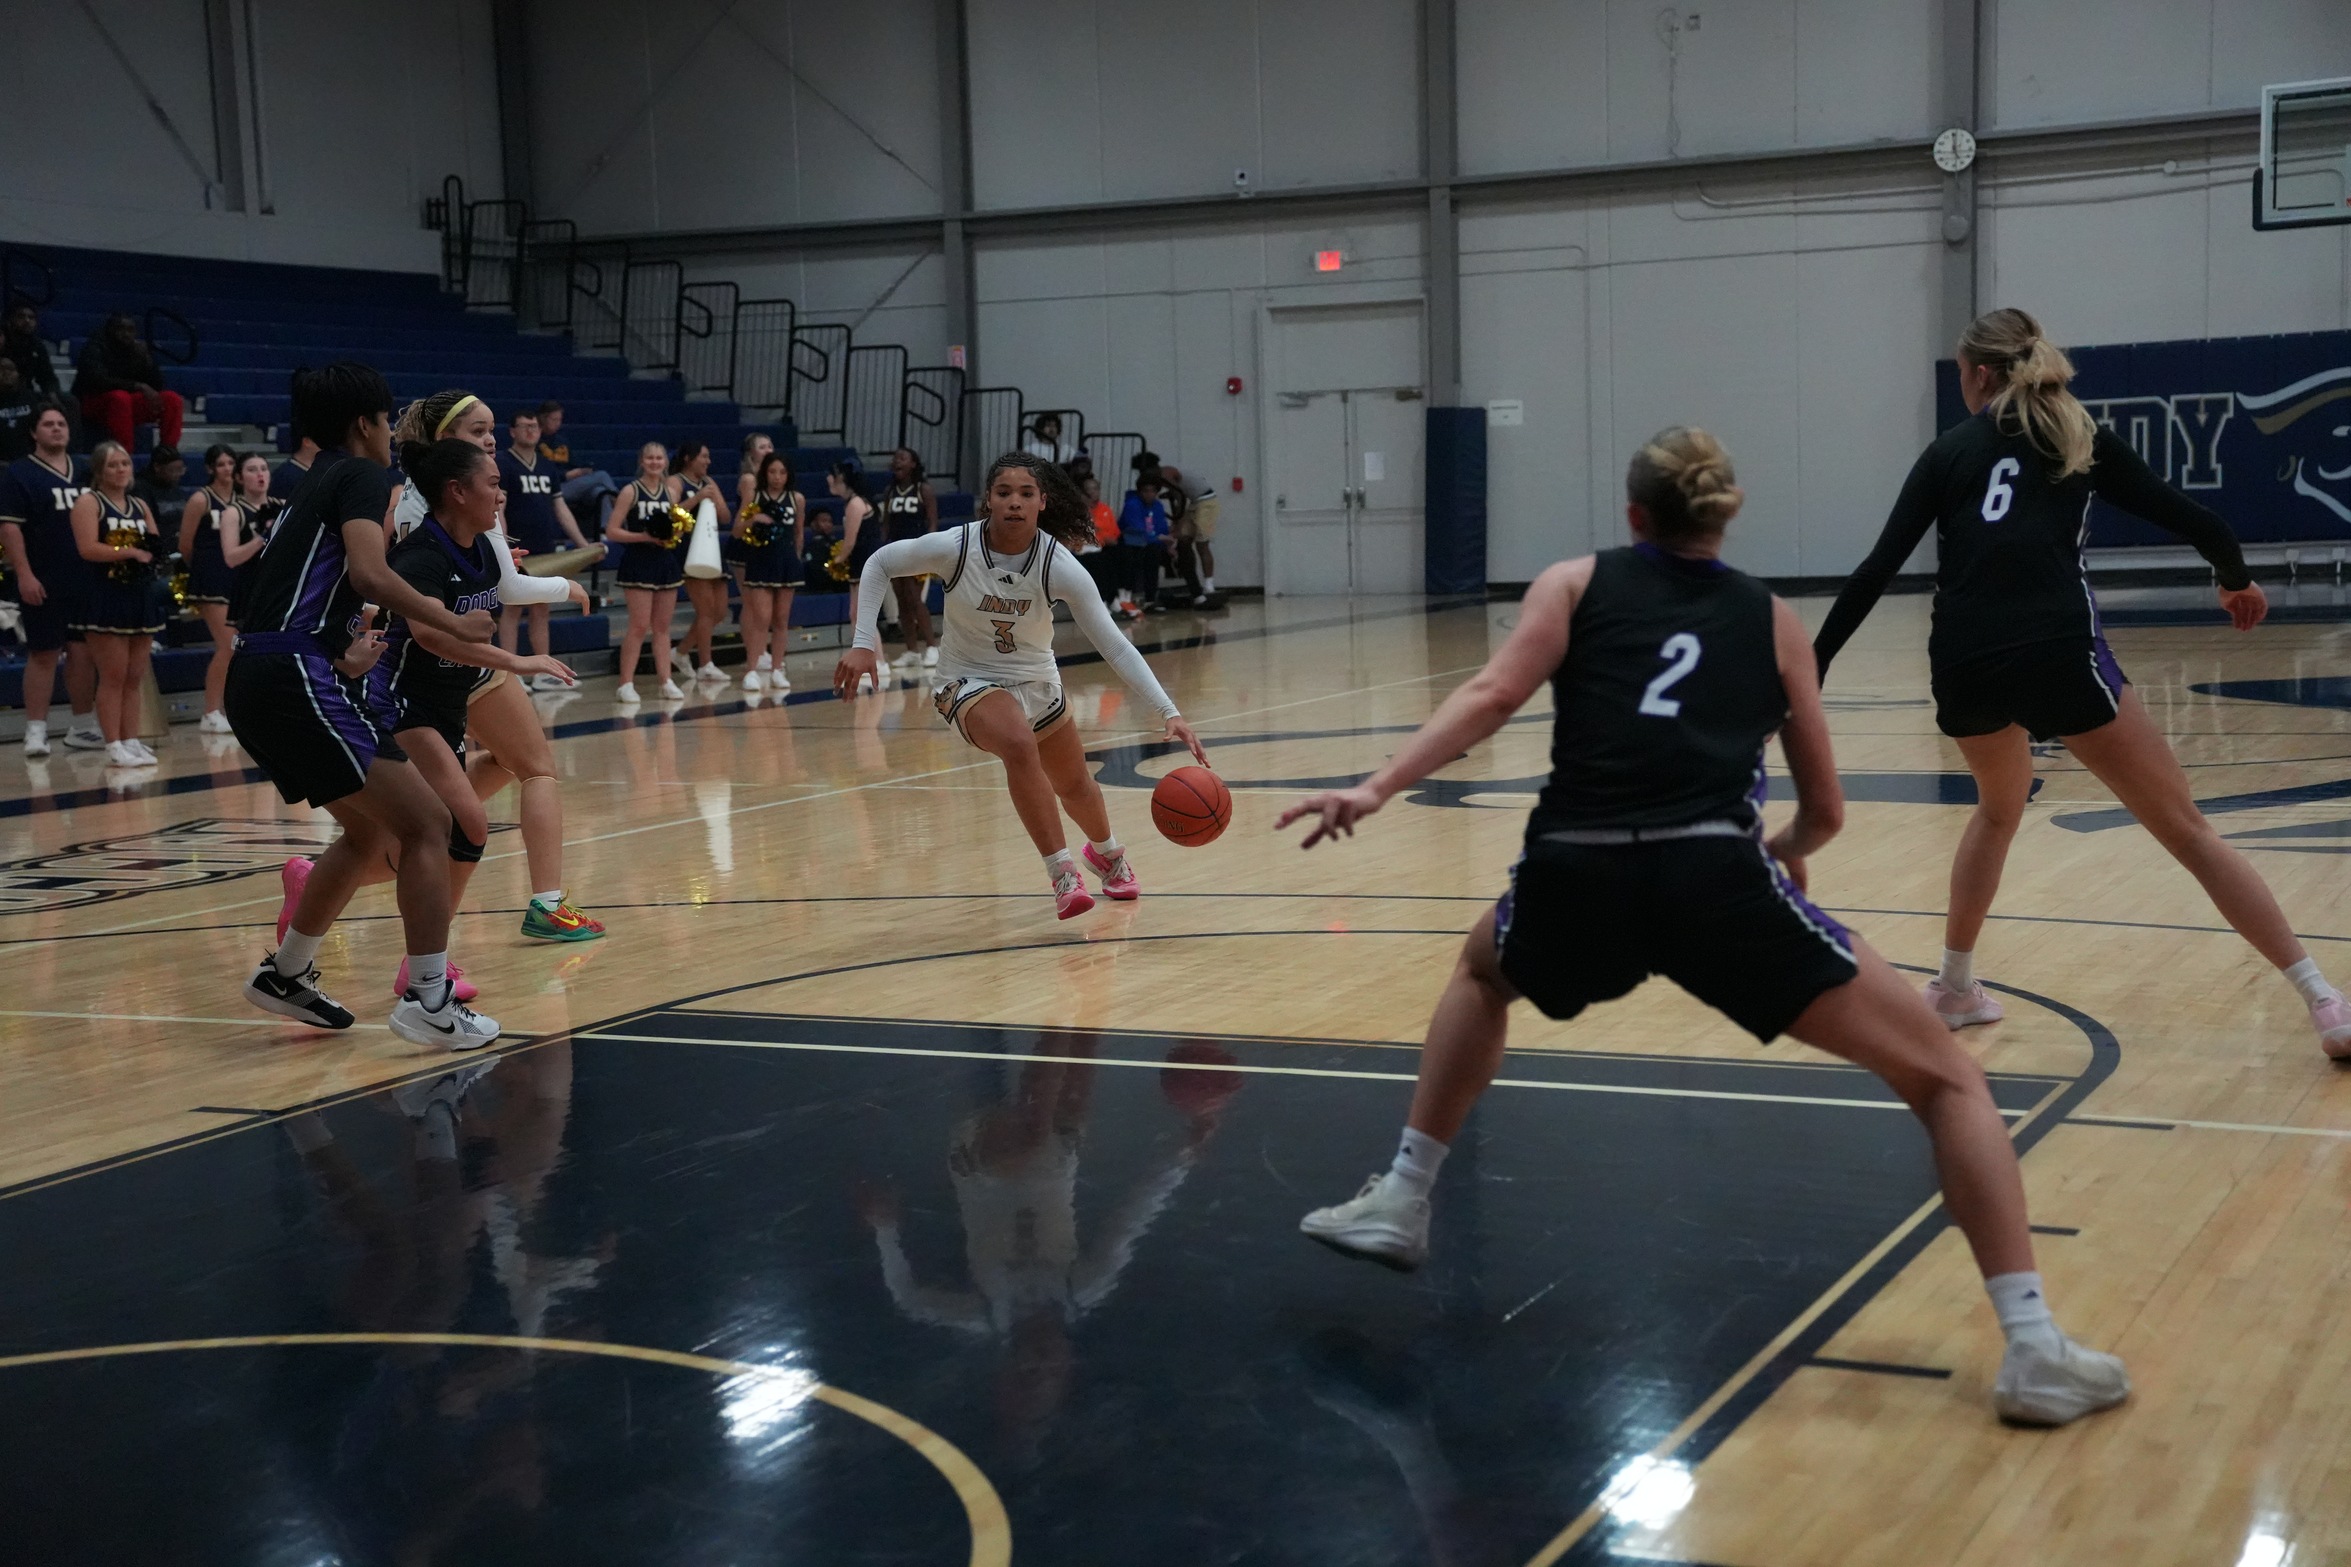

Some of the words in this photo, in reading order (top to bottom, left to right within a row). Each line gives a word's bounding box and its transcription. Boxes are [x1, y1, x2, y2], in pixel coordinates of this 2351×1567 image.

[2080, 391, 2235, 490] DY
[51, 487, 92, 511] IC
[519, 475, 552, 494] ICC
[1980, 456, 2021, 522] 6
[454, 586, 499, 615] DODG
[976, 594, 1033, 617] INDY
[990, 619, 1018, 654] 3
[1637, 631, 1702, 719] 2
